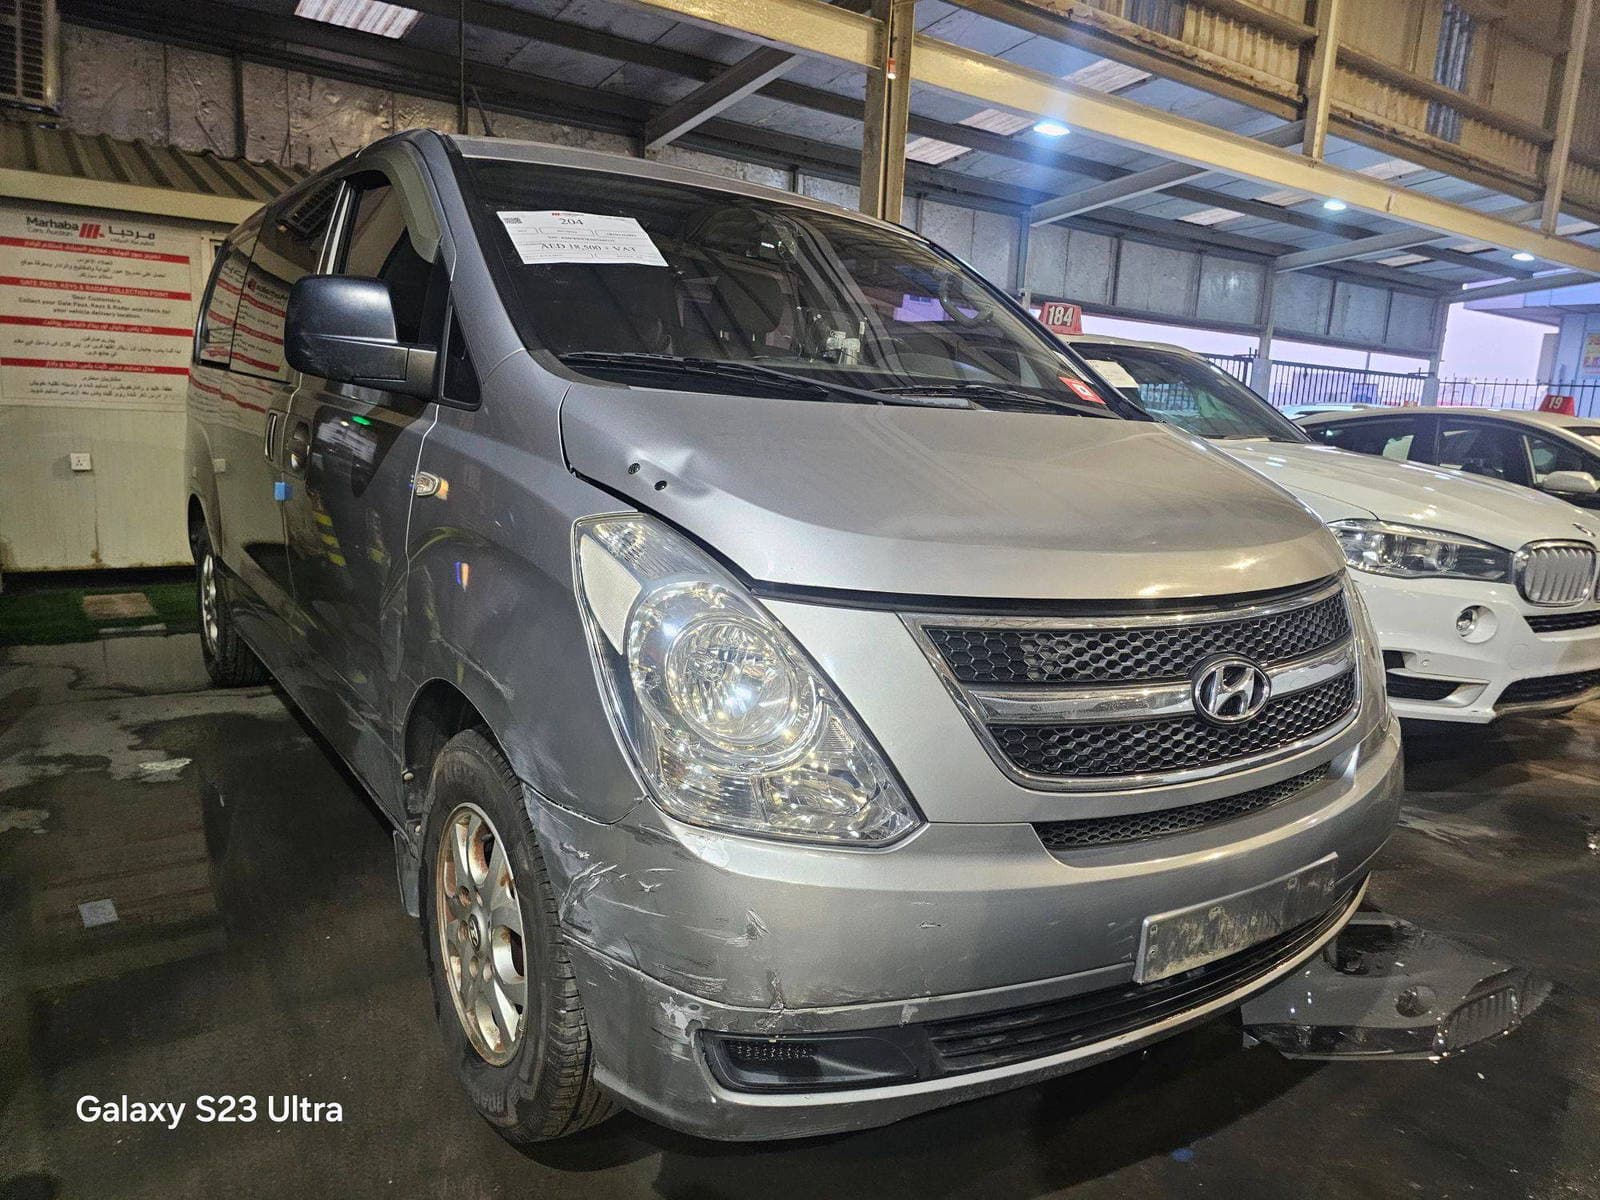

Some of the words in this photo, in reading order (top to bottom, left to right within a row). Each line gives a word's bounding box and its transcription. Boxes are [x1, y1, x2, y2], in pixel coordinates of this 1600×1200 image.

[26, 216, 79, 231] Marhaba
[560, 217, 585, 226] 204
[541, 242, 566, 250] AED
[1047, 306, 1075, 326] 184
[1548, 396, 1563, 409] 19
